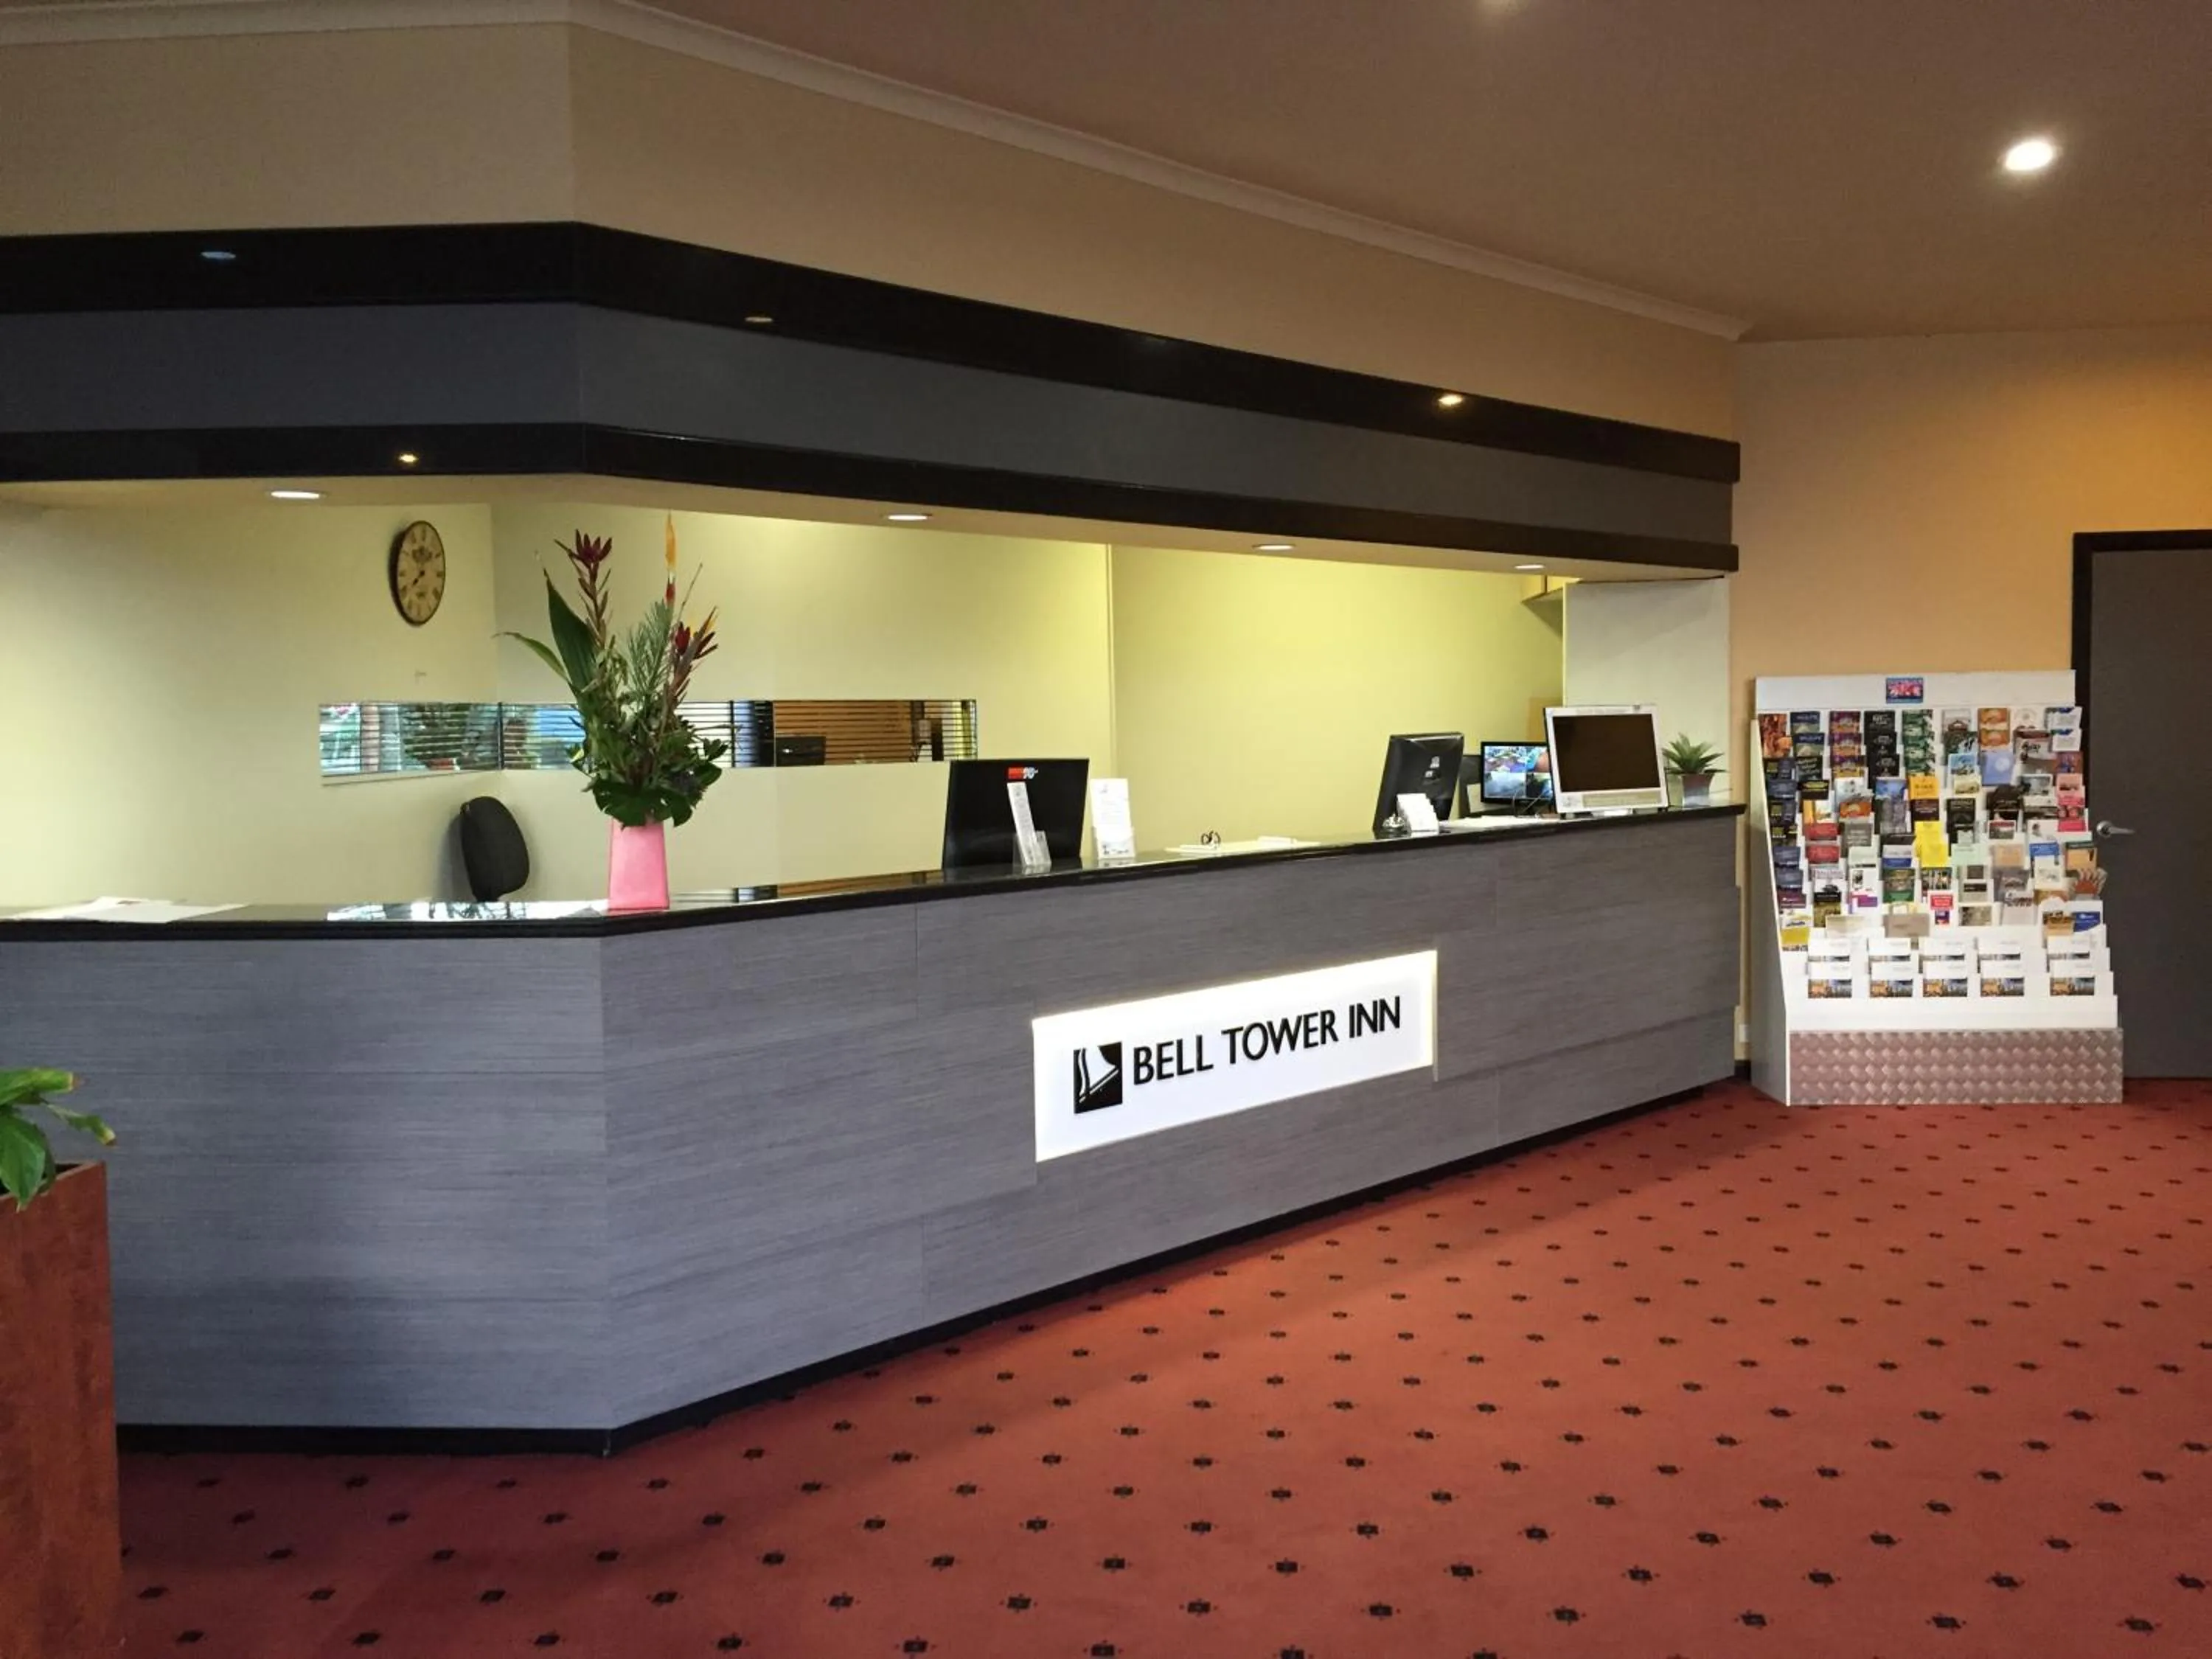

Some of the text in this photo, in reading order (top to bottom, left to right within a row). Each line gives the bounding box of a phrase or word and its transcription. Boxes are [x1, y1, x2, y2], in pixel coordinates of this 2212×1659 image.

[1133, 995, 1400, 1085] BELL TOWER INN
